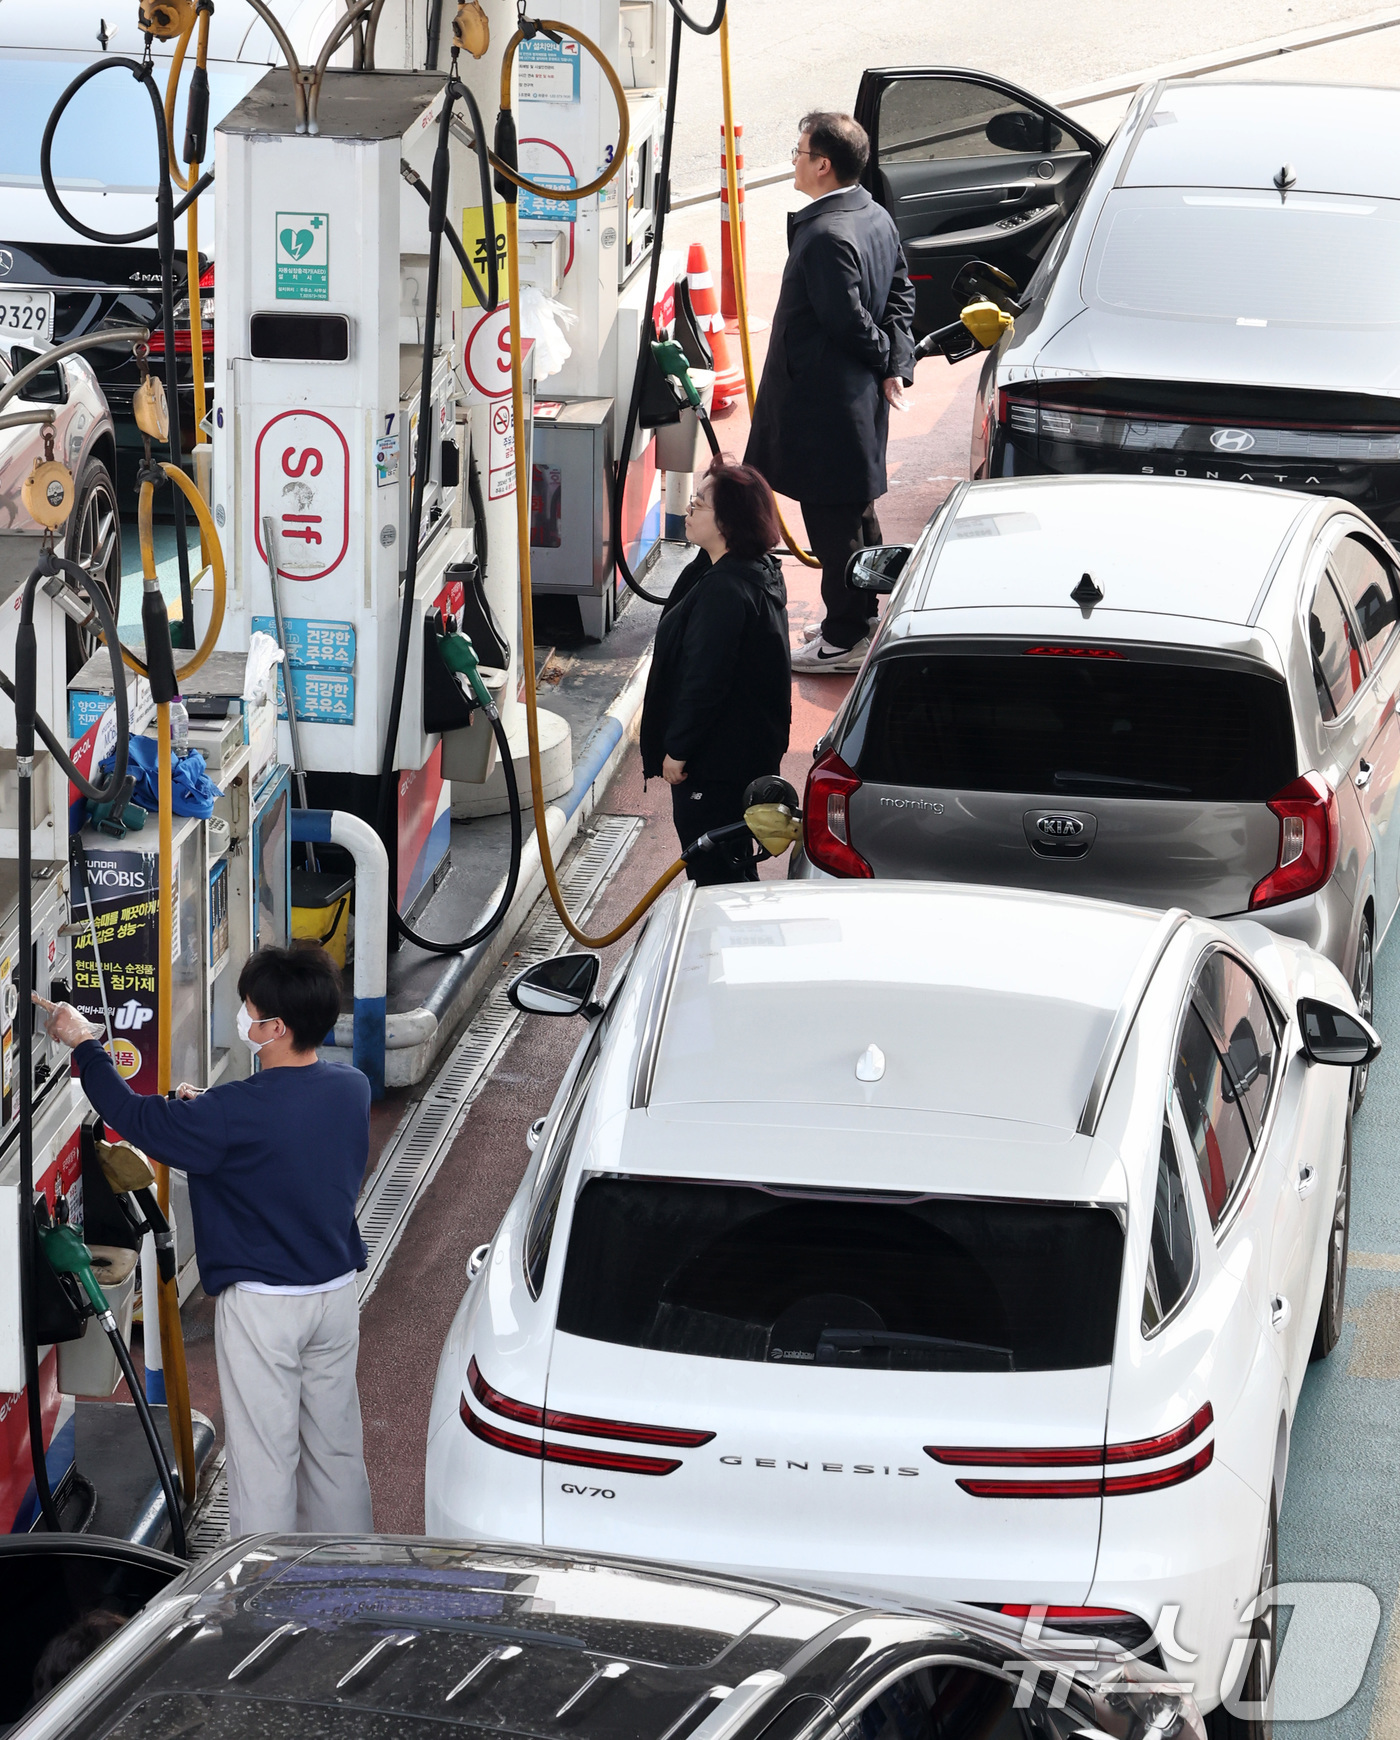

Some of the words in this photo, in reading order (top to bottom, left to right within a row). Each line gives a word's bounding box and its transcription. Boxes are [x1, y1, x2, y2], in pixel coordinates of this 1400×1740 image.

[533, 42, 560, 52] 설치안내
[605, 144, 614, 164] 3
[128, 271, 178, 282] 4MATC
[216, 407, 224, 428] 6
[385, 413, 395, 435] 7
[1141, 466, 1321, 484] SONATA
[306, 630, 351, 646] 건강한
[306, 645, 349, 661] 주유소
[304, 681, 349, 698] 건강한
[304, 697, 347, 714] 주유소
[880, 797, 944, 815] morning
[1043, 820, 1076, 834] KIA
[74, 860, 117, 869] HUNDAI
[87, 869, 146, 888] MOBIS
[110, 974, 155, 992] 첨가제
[114, 998, 154, 1030] UP
[719, 1455, 920, 1477] GENESIS
[561, 1483, 616, 1499] GV70
